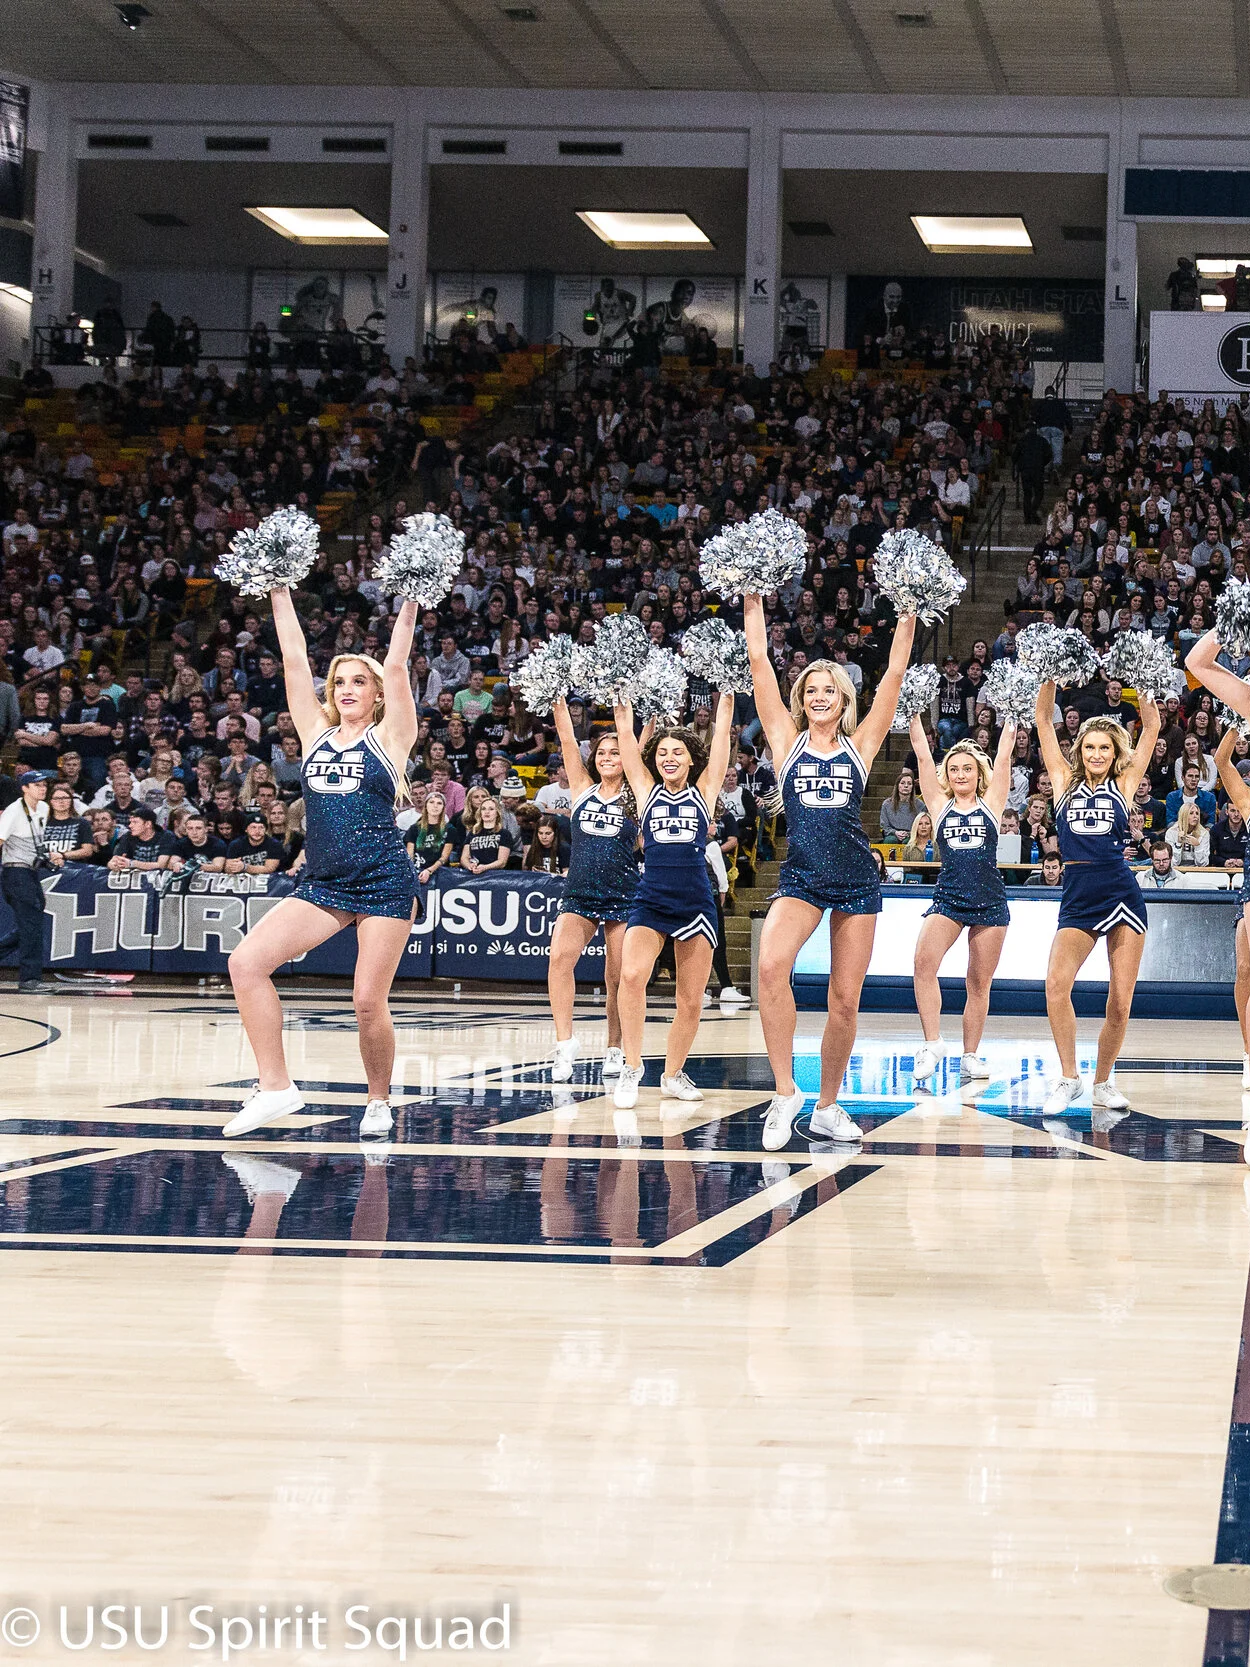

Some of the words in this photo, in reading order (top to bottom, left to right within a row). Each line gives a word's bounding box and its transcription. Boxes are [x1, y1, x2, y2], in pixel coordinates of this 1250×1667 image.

[38, 268, 52, 283] H
[396, 274, 407, 289] J
[753, 278, 767, 294] K
[1115, 285, 1126, 301] L
[950, 287, 1031, 312] UTAH
[690, 694, 712, 704] TRUE
[305, 762, 365, 779] STATE
[794, 777, 853, 794] STATE
[579, 809, 624, 827] STATE
[1066, 808, 1115, 823] STATE
[649, 817, 698, 832] STATE
[943, 825, 986, 838] STATE
[41, 873, 300, 961] HUR
